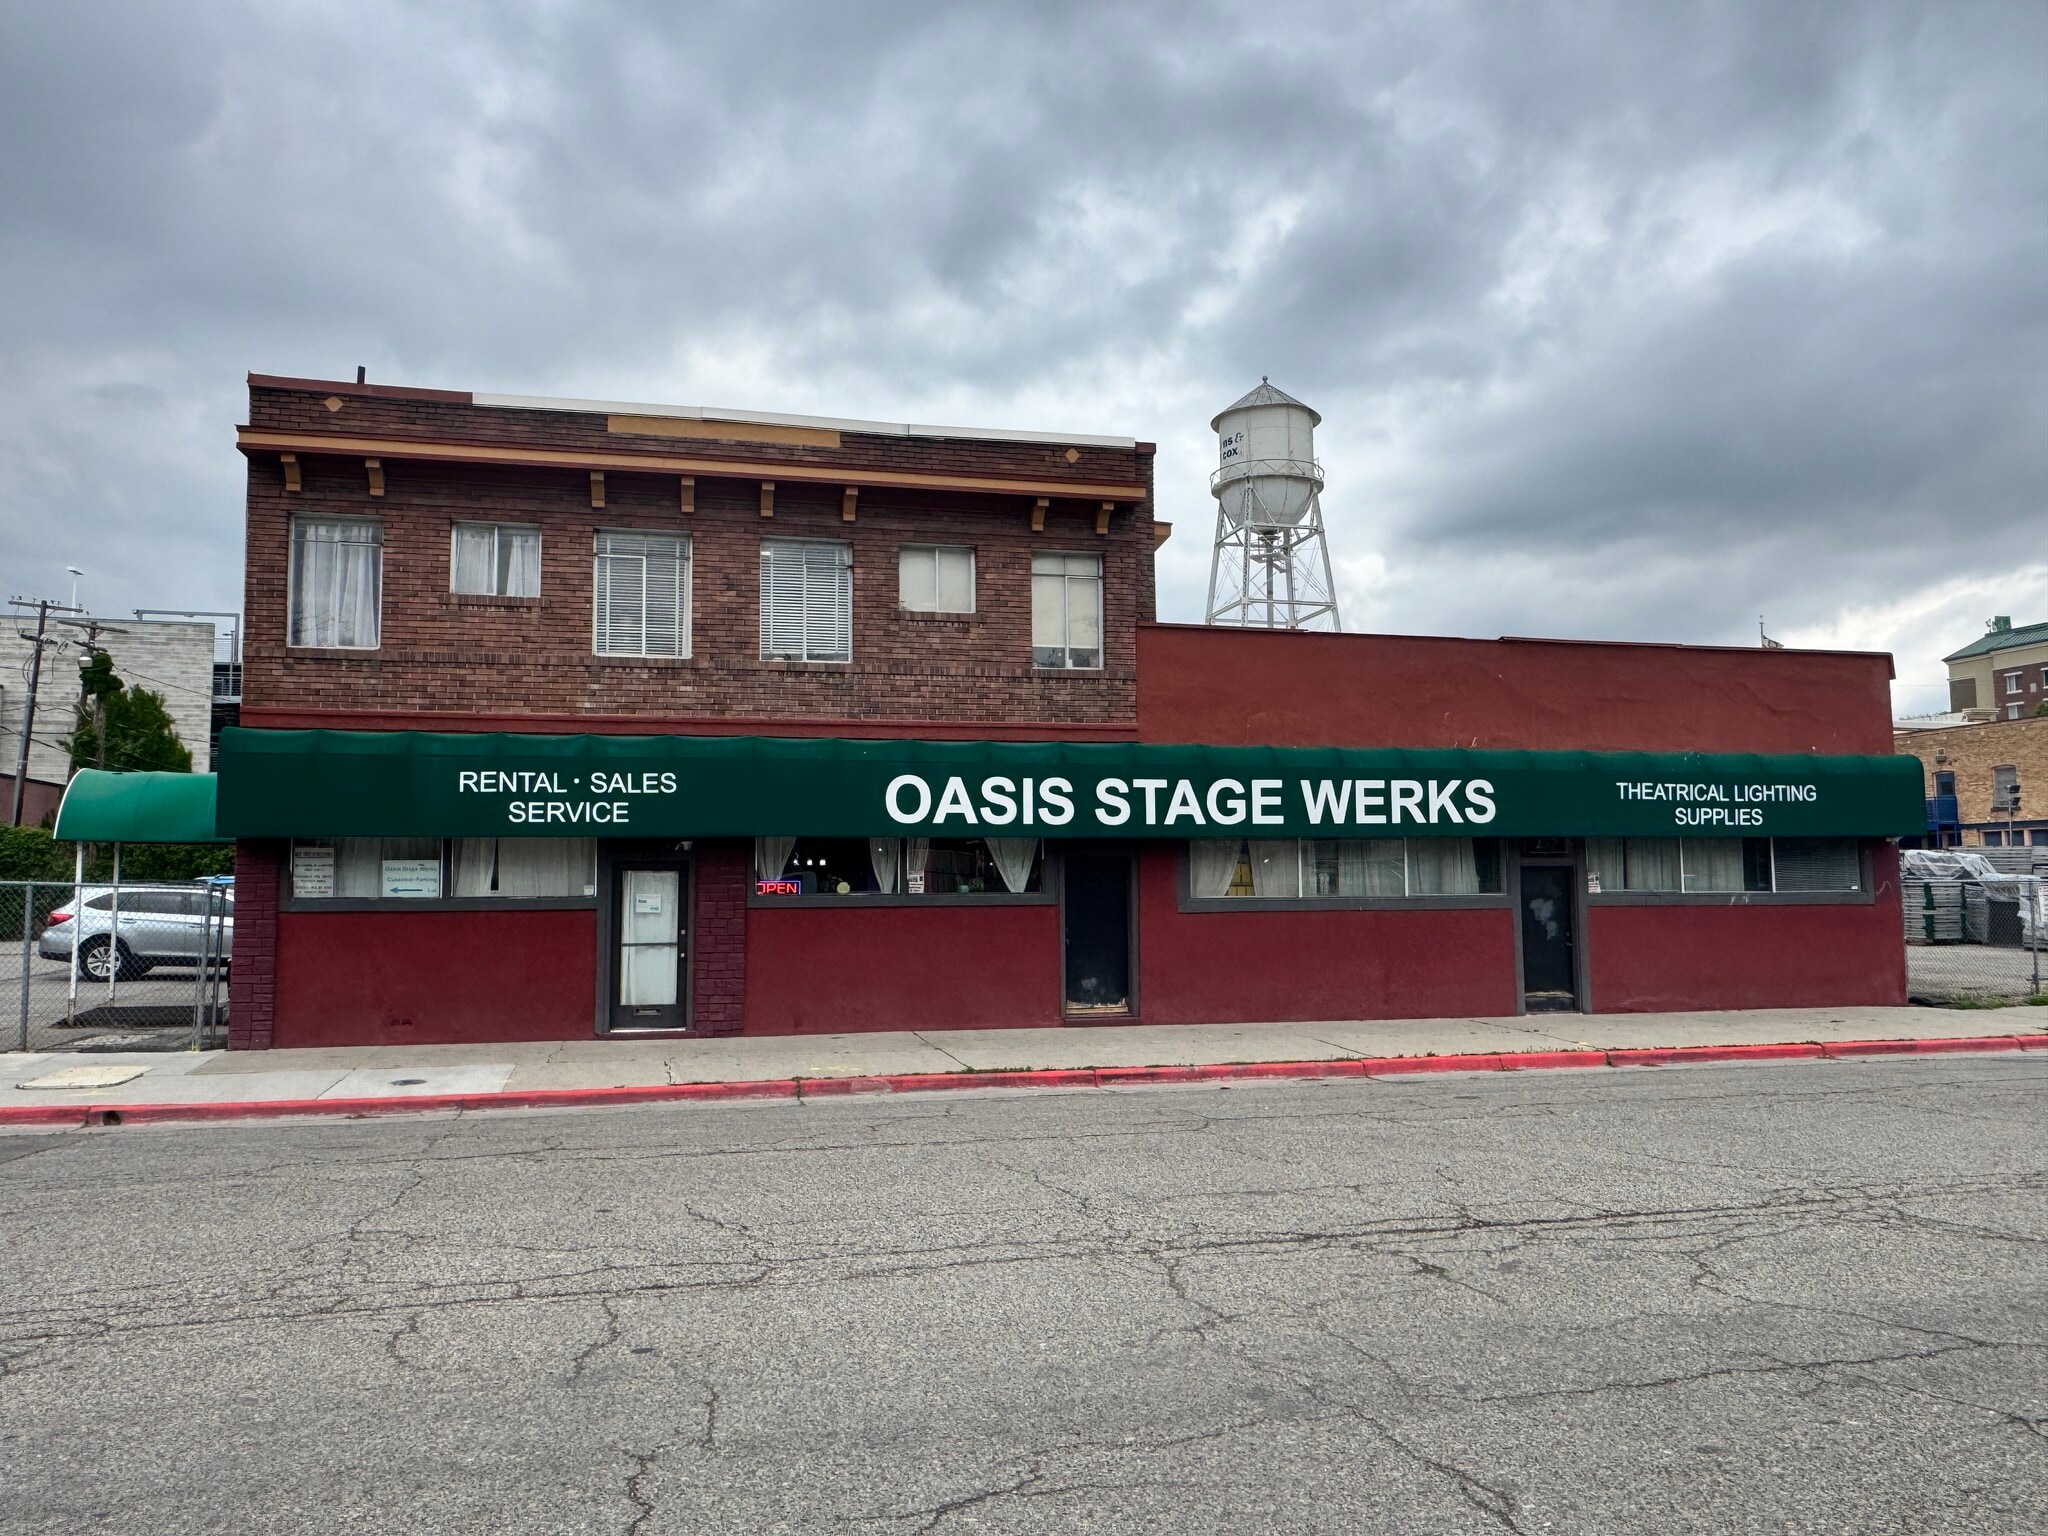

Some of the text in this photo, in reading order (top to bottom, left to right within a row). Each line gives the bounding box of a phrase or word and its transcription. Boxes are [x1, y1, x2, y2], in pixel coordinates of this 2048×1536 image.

[459, 771, 677, 795] RENTAL SALES
[1615, 782, 1818, 803] THEATRICAL LIGHTING
[885, 774, 1497, 826] OASIS STAGE WERKS
[508, 801, 630, 824] SERVICE
[1674, 807, 1764, 827] SUPPLIES
